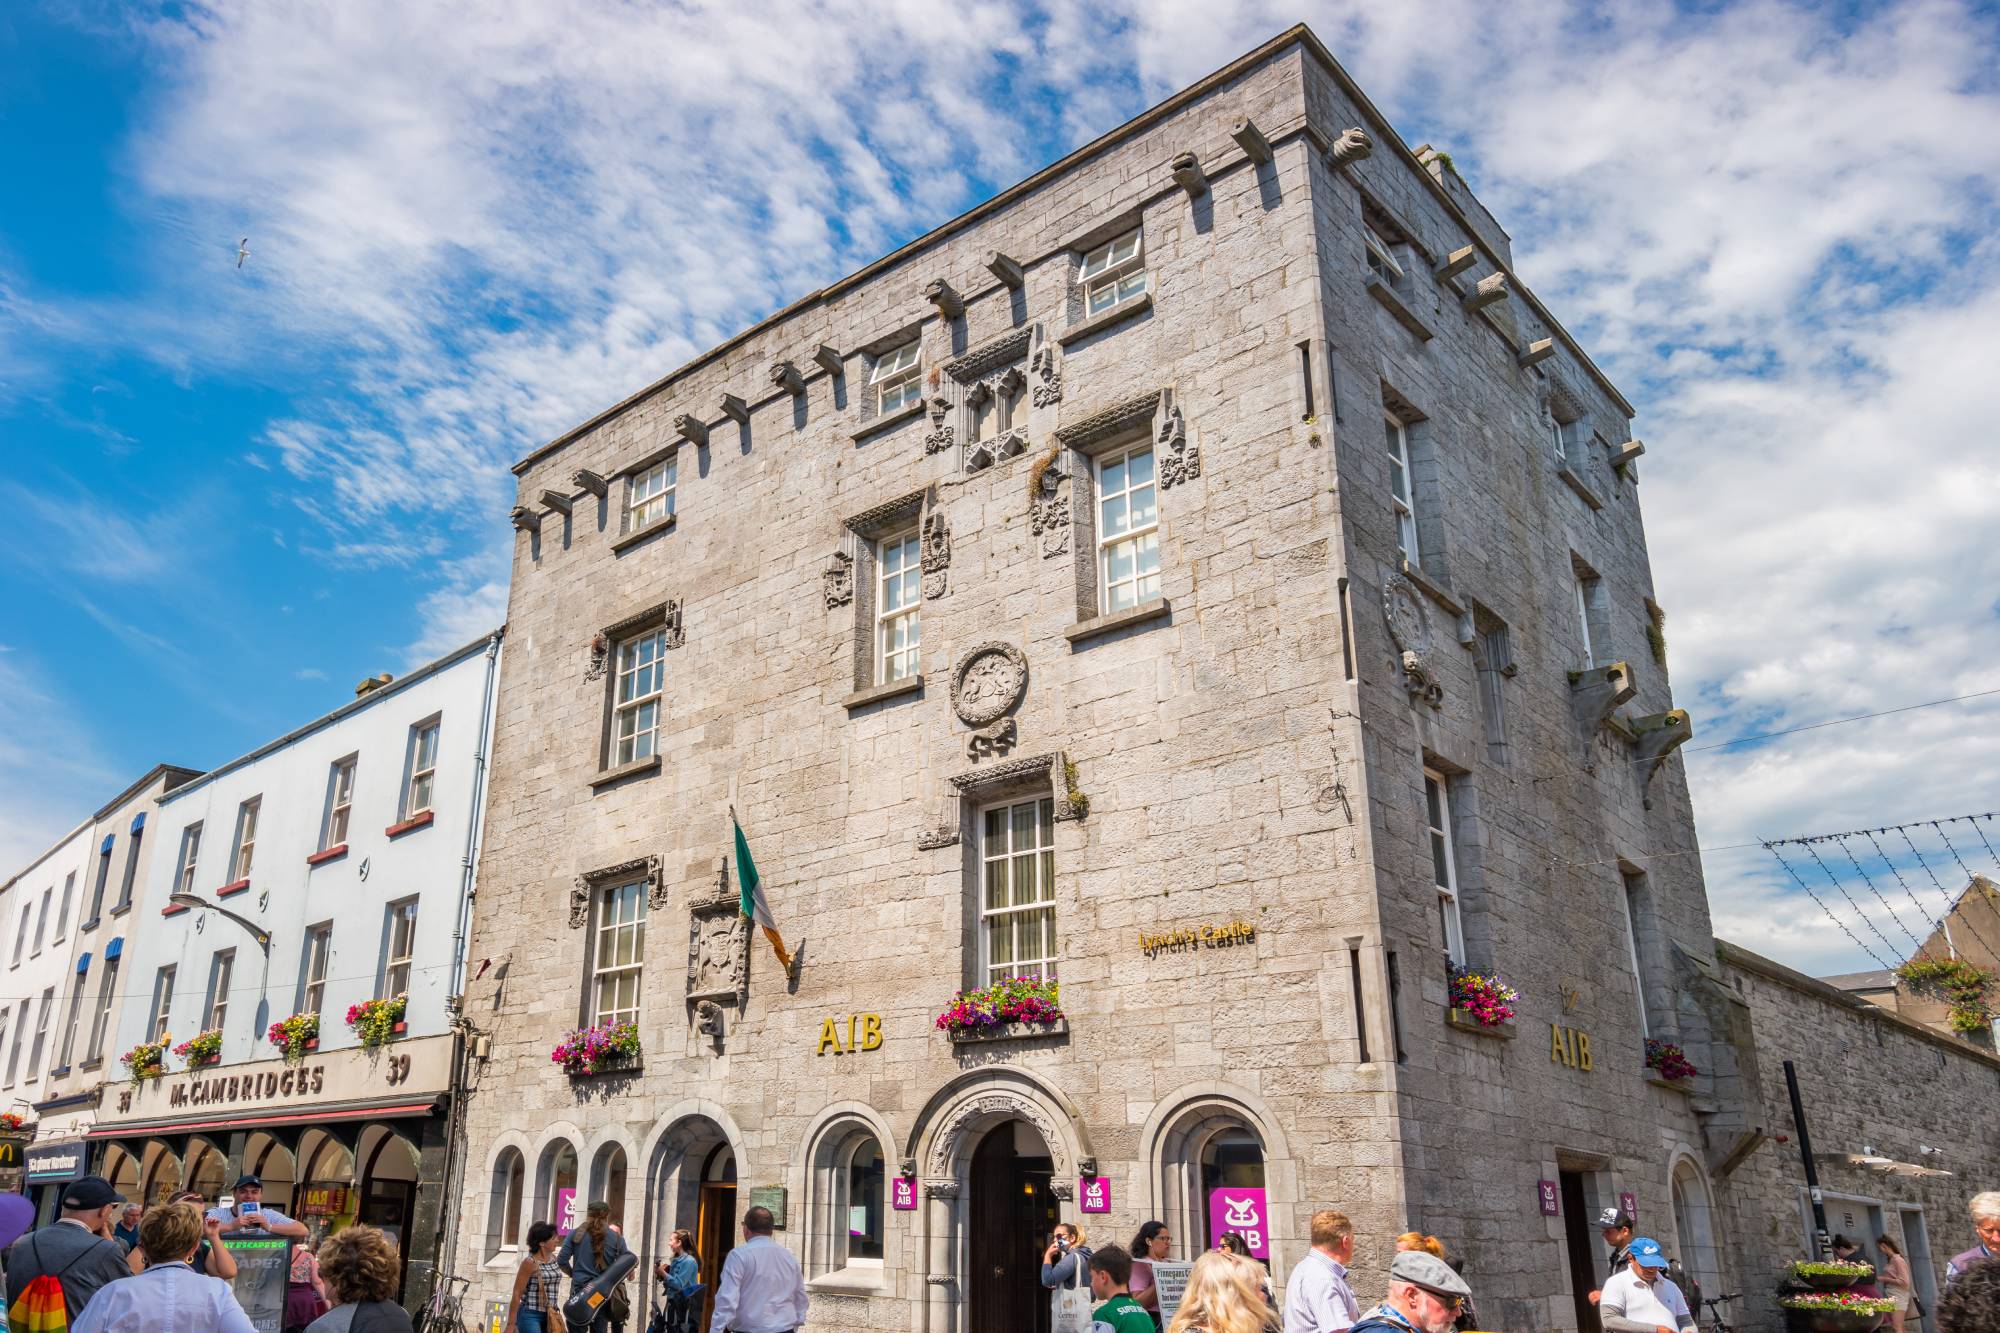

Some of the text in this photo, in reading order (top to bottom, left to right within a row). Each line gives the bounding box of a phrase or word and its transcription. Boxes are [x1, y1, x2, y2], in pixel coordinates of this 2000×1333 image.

[1138, 920, 1252, 951] Lynch's Castle
[816, 1012, 884, 1055] AIB
[1550, 1023, 1593, 1072] AIB
[386, 1053, 411, 1087] 39
[116, 1090, 132, 1114] 39
[896, 1195, 911, 1205] AIB
[1085, 1197, 1104, 1208] AIB
[1544, 1200, 1556, 1211] AIB
[561, 1216, 574, 1231] AI
[238, 1257, 282, 1269] APE?
[1157, 1269, 1185, 1279] Finnegans
